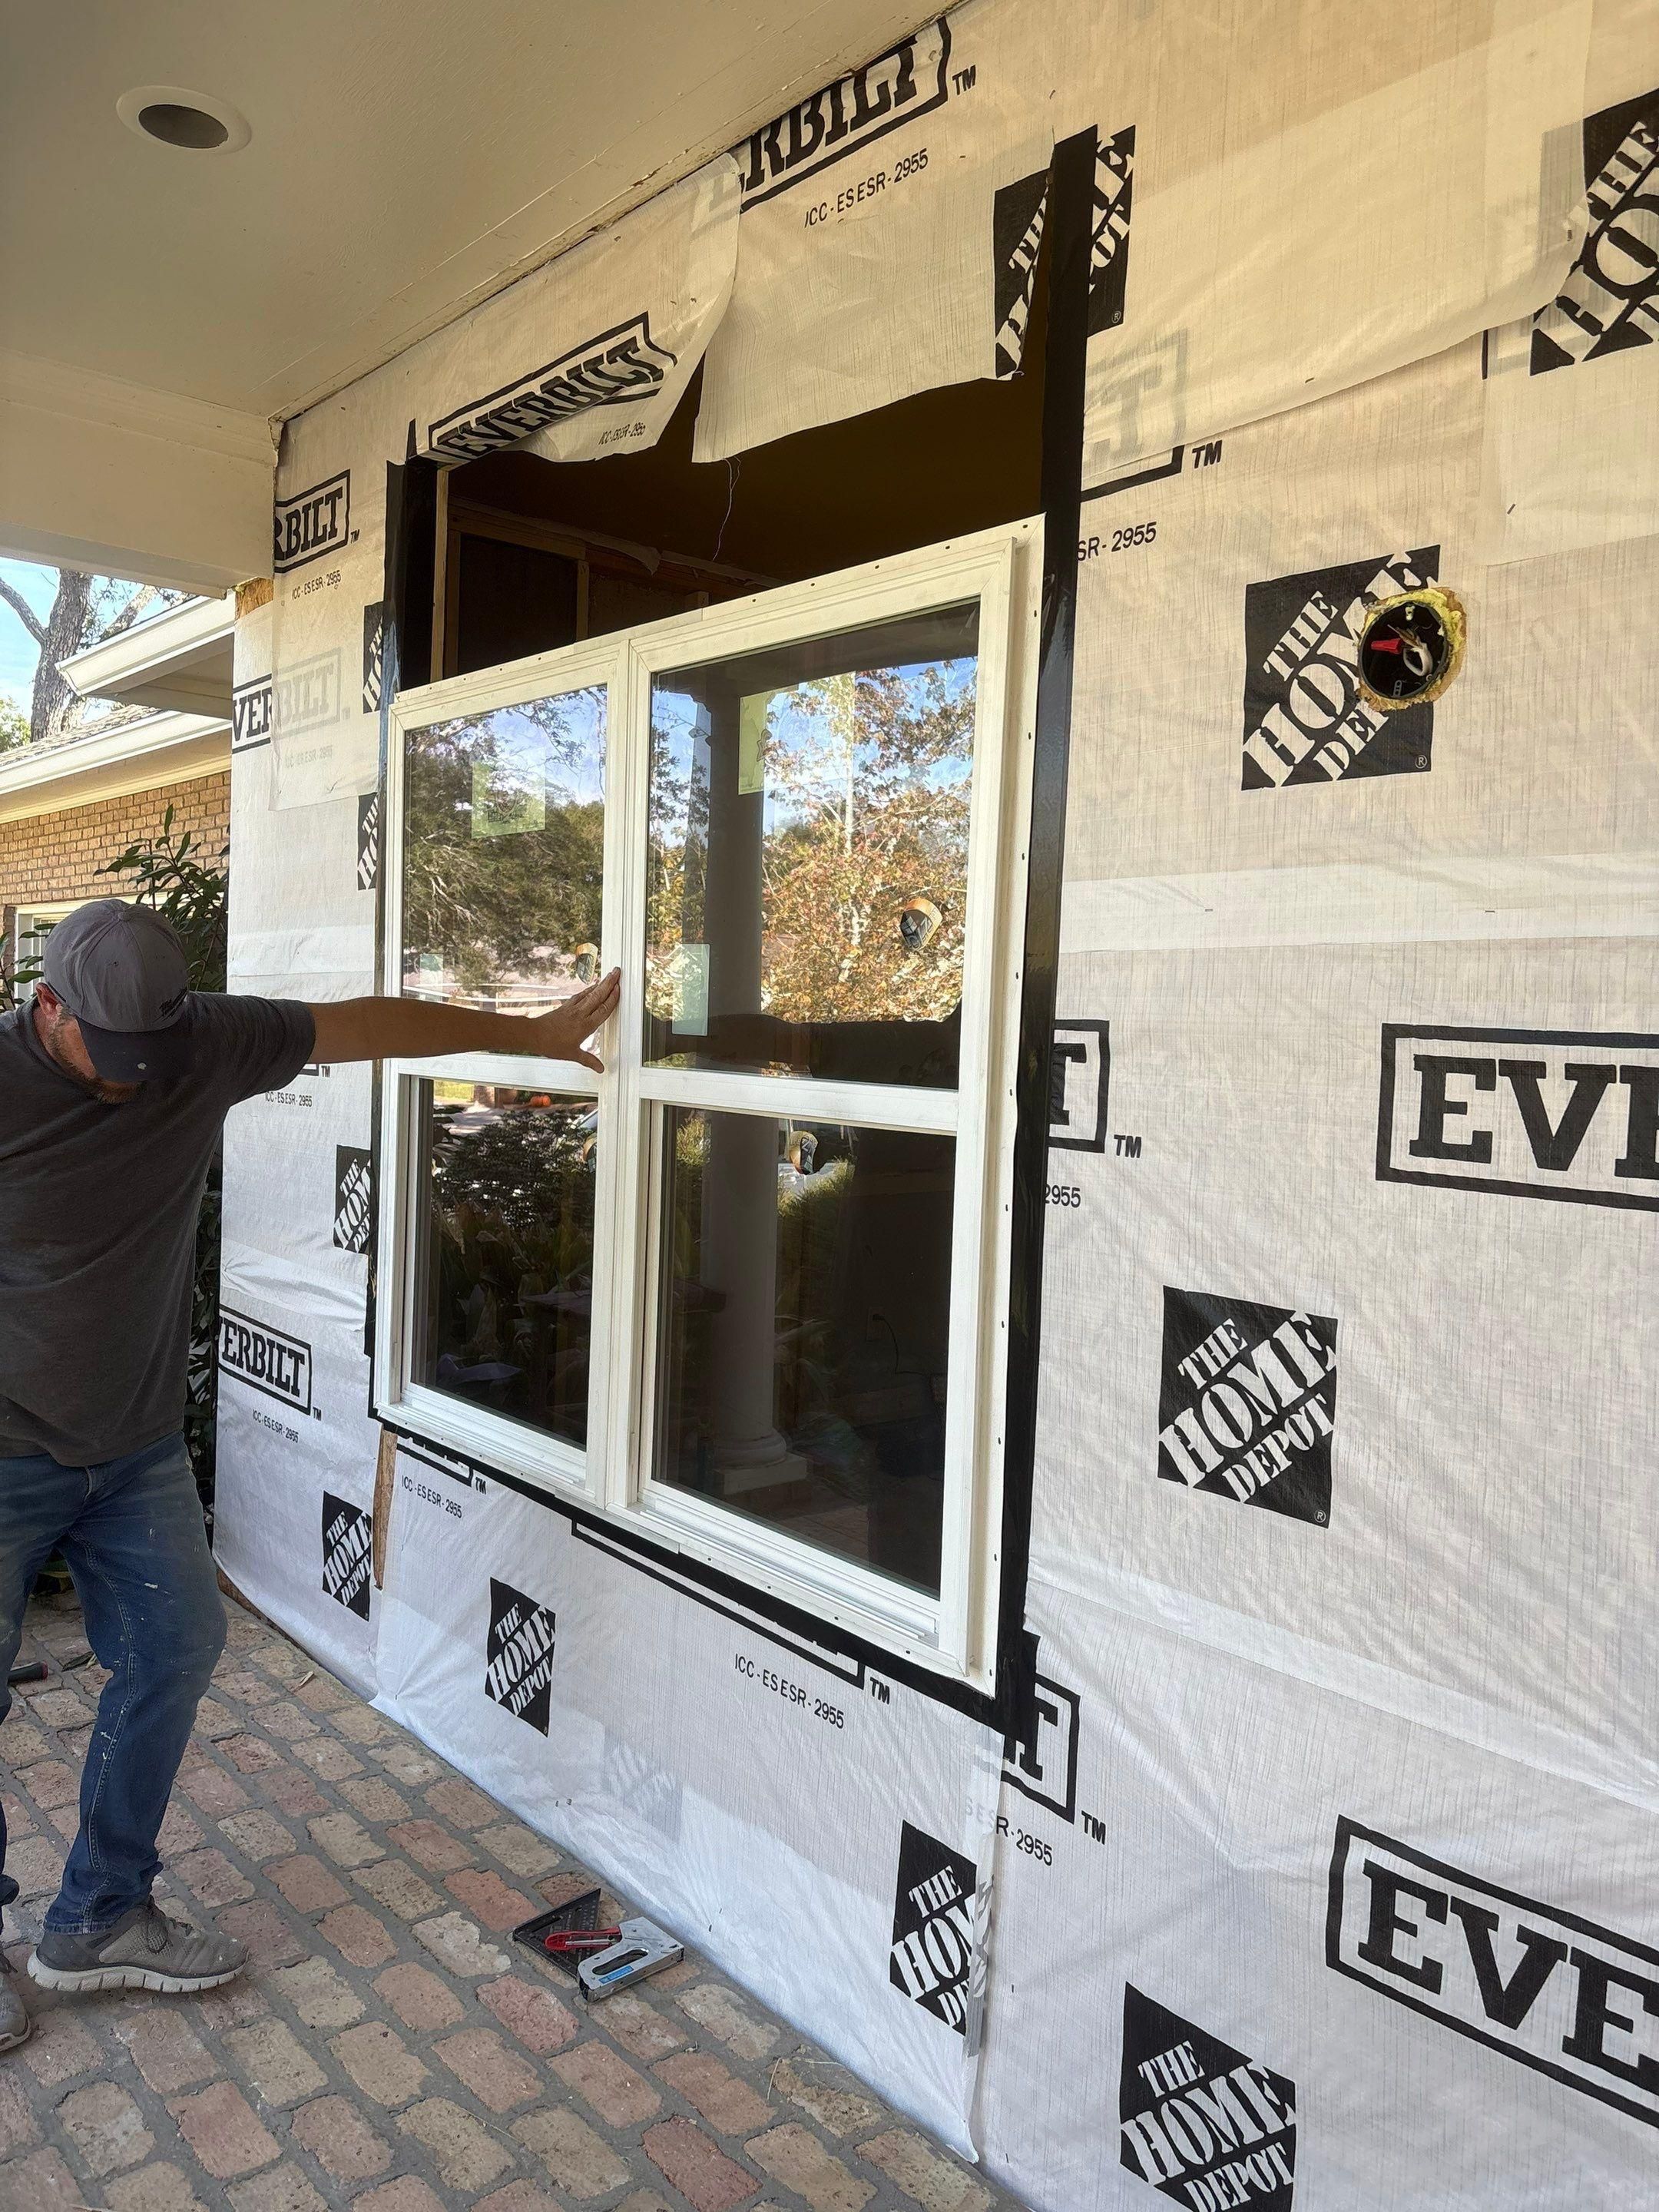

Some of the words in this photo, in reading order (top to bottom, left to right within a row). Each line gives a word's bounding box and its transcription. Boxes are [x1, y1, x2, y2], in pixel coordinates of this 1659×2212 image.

[952, 65, 976, 96] TM
[739, 34, 918, 193] RBILT
[1192, 439, 1223, 469] TM
[1262, 591, 1339, 682] THE
[1114, 1134, 1142, 1159] TM
[333, 1158, 370, 1250] HOM
[340, 1157, 362, 1198] THE
[220, 1316, 306, 1398] ERBILT
[1177, 1317, 1248, 1390] THE
[1158, 1310, 1336, 1488] HOME
[1221, 1392, 1335, 1503] DEPOT
[475, 1476, 487, 1495] TM
[323, 1511, 372, 1597] HOME
[326, 1510, 349, 1548] THE
[340, 1554, 372, 1607] DEPOT
[495, 1602, 522, 1644] THE
[487, 1604, 556, 1704] HOME
[508, 1655, 552, 1717] DEPOT
[869, 1677, 891, 1705] TM
[1081, 1810, 1107, 1845] TM
[908, 1865, 962, 1919] THE
[1137, 2040, 1206, 2098] THE
[1121, 2064, 1296, 2186] HOME
[1183, 2141, 1295, 2212] DEPOT
